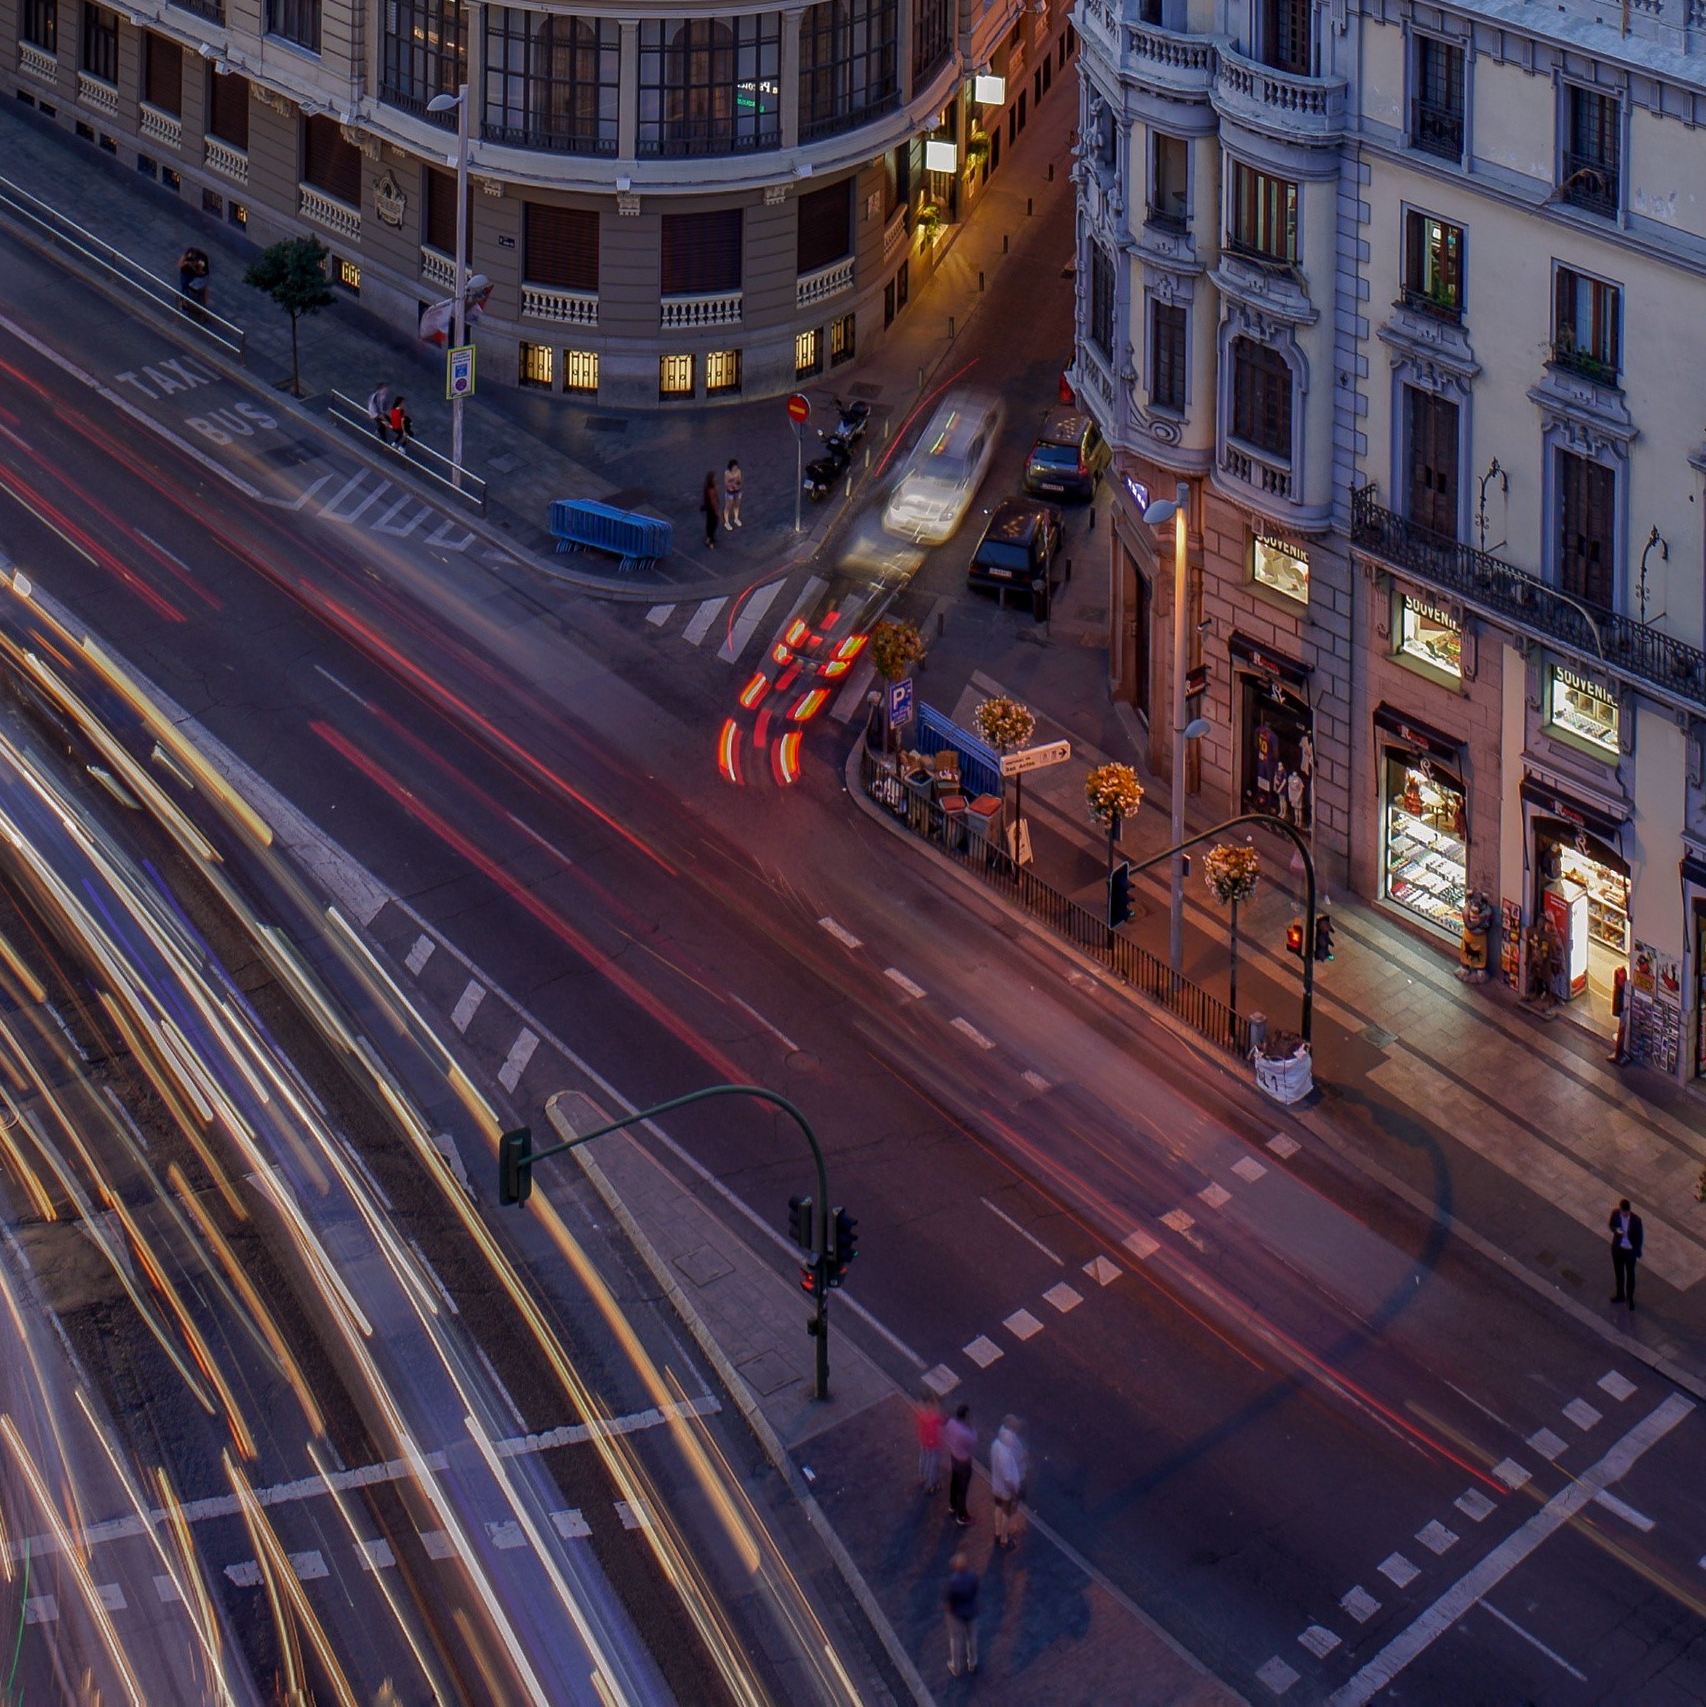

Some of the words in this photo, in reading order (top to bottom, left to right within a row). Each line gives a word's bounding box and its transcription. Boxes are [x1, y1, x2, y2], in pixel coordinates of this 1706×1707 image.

[114, 355, 222, 400] TAXI
[184, 401, 279, 446] BUS
[893, 686, 906, 711] P
